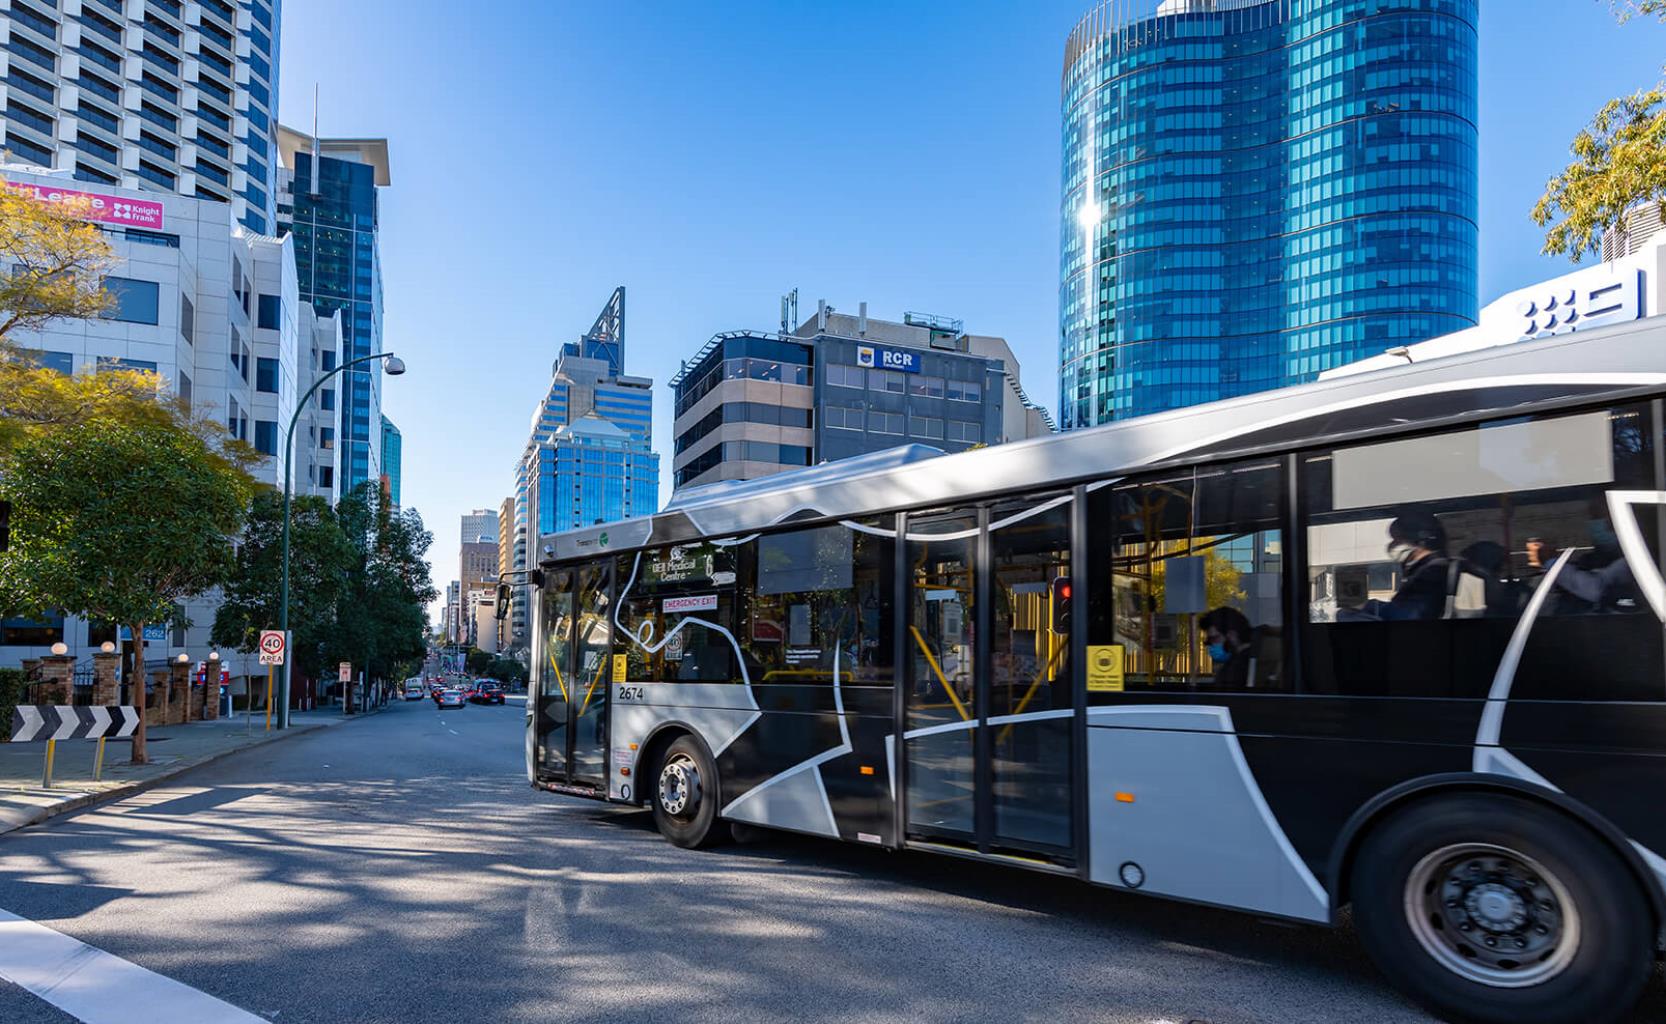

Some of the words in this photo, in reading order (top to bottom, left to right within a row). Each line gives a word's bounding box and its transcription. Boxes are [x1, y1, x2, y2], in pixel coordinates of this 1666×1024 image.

[132, 205, 160, 216] Knight
[132, 213, 156, 223] Frank
[883, 351, 912, 366] RCR
[667, 558, 696, 571] Medical
[706, 555, 714, 577] 6
[145, 629, 164, 638] 262
[264, 639, 280, 648] 40
[260, 655, 282, 663] AREA
[619, 687, 643, 700] 2674
